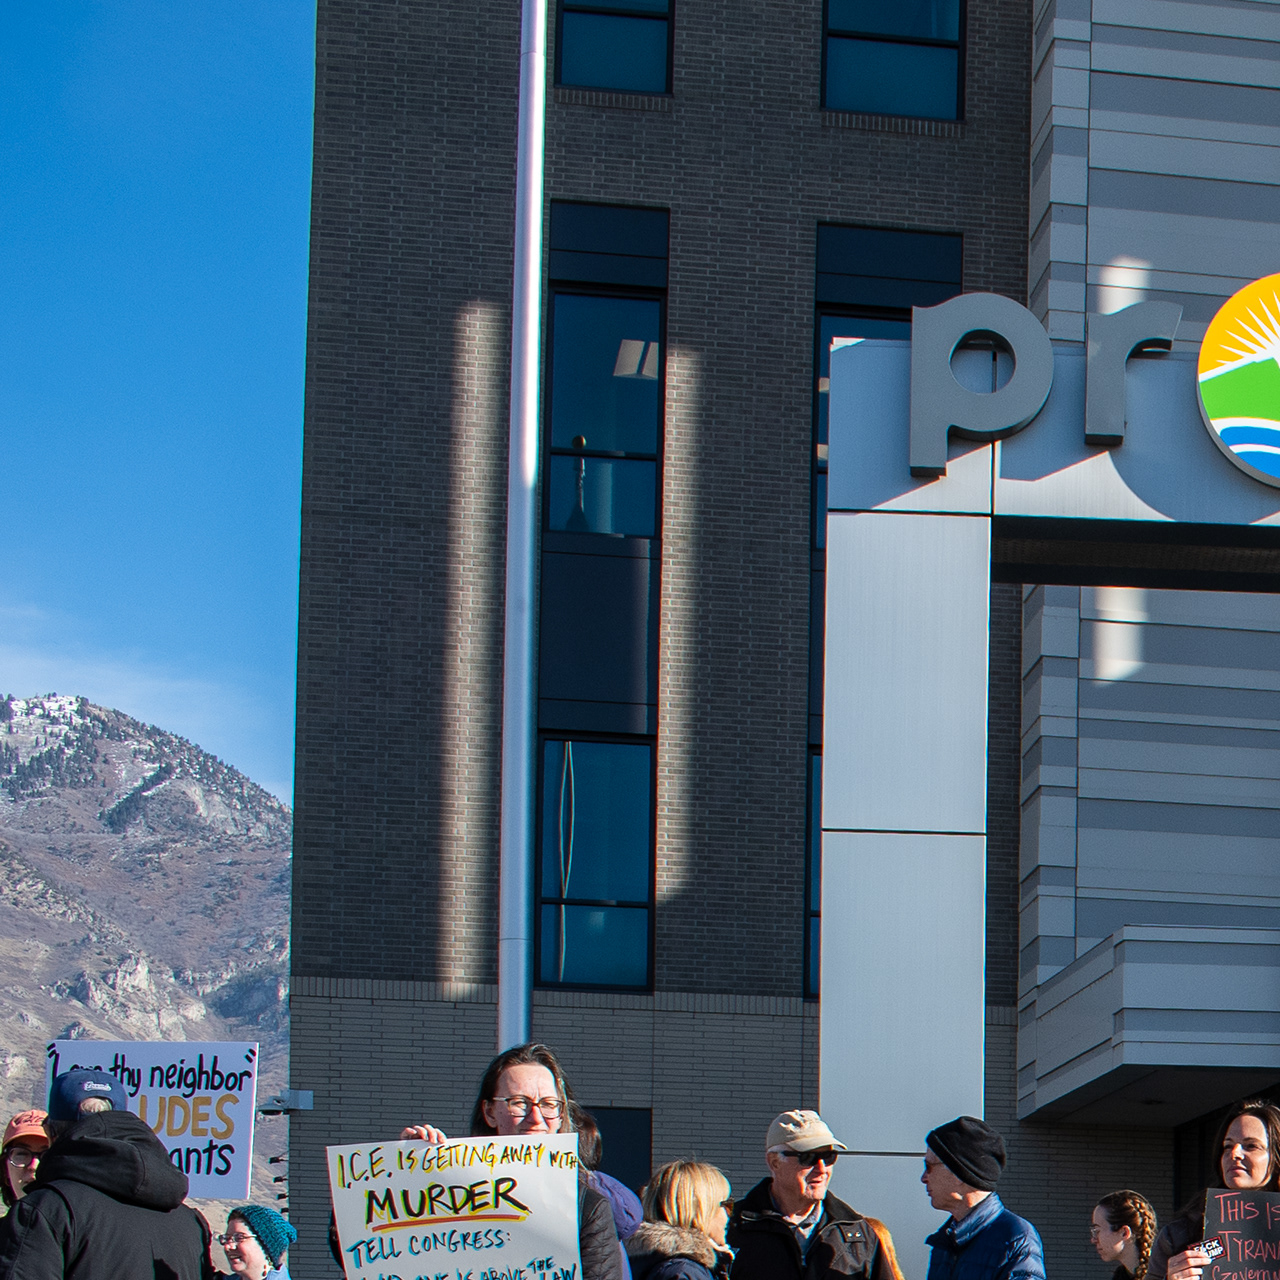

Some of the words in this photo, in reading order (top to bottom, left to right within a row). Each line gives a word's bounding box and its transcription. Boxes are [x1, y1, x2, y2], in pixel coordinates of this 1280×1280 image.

[108, 1053, 142, 1098] thy
[338, 1146, 394, 1190] I.C.E.
[397, 1147, 420, 1174] IS
[421, 1142, 500, 1174] GETTING
[500, 1142, 545, 1168] AWAY
[549, 1150, 578, 1170] WITH
[365, 1176, 533, 1228] MURDER
[1215, 1192, 1260, 1224] THIS
[346, 1236, 403, 1270] TELL
[409, 1228, 512, 1254] CONGRESS:
[526, 1256, 556, 1272] THE
